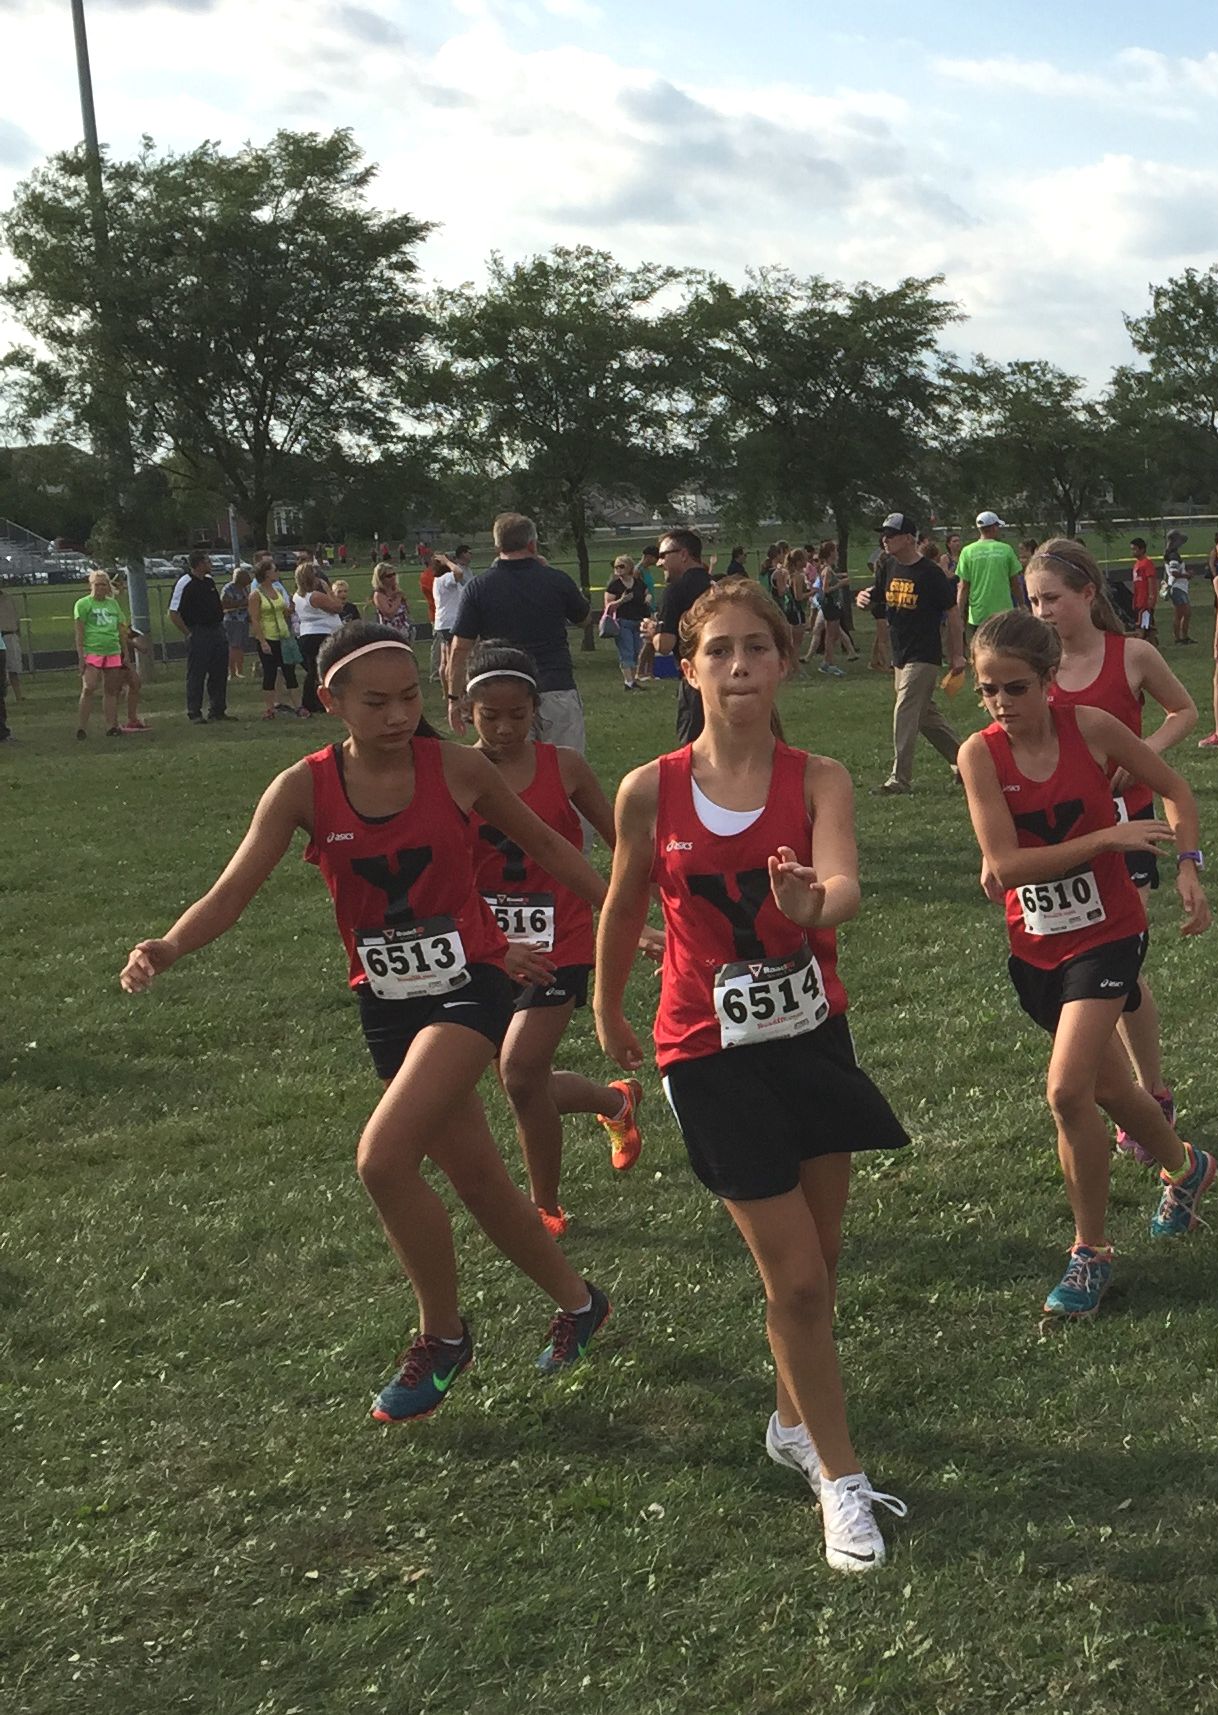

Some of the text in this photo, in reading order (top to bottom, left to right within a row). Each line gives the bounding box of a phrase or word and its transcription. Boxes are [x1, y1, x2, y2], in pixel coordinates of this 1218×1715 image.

[335, 832, 354, 841] asics
[351, 846, 432, 923] Y
[1022, 877, 1091, 913] 6510
[686, 868, 771, 960] Y
[366, 937, 456, 978] 6513
[723, 964, 820, 1025] 6514
